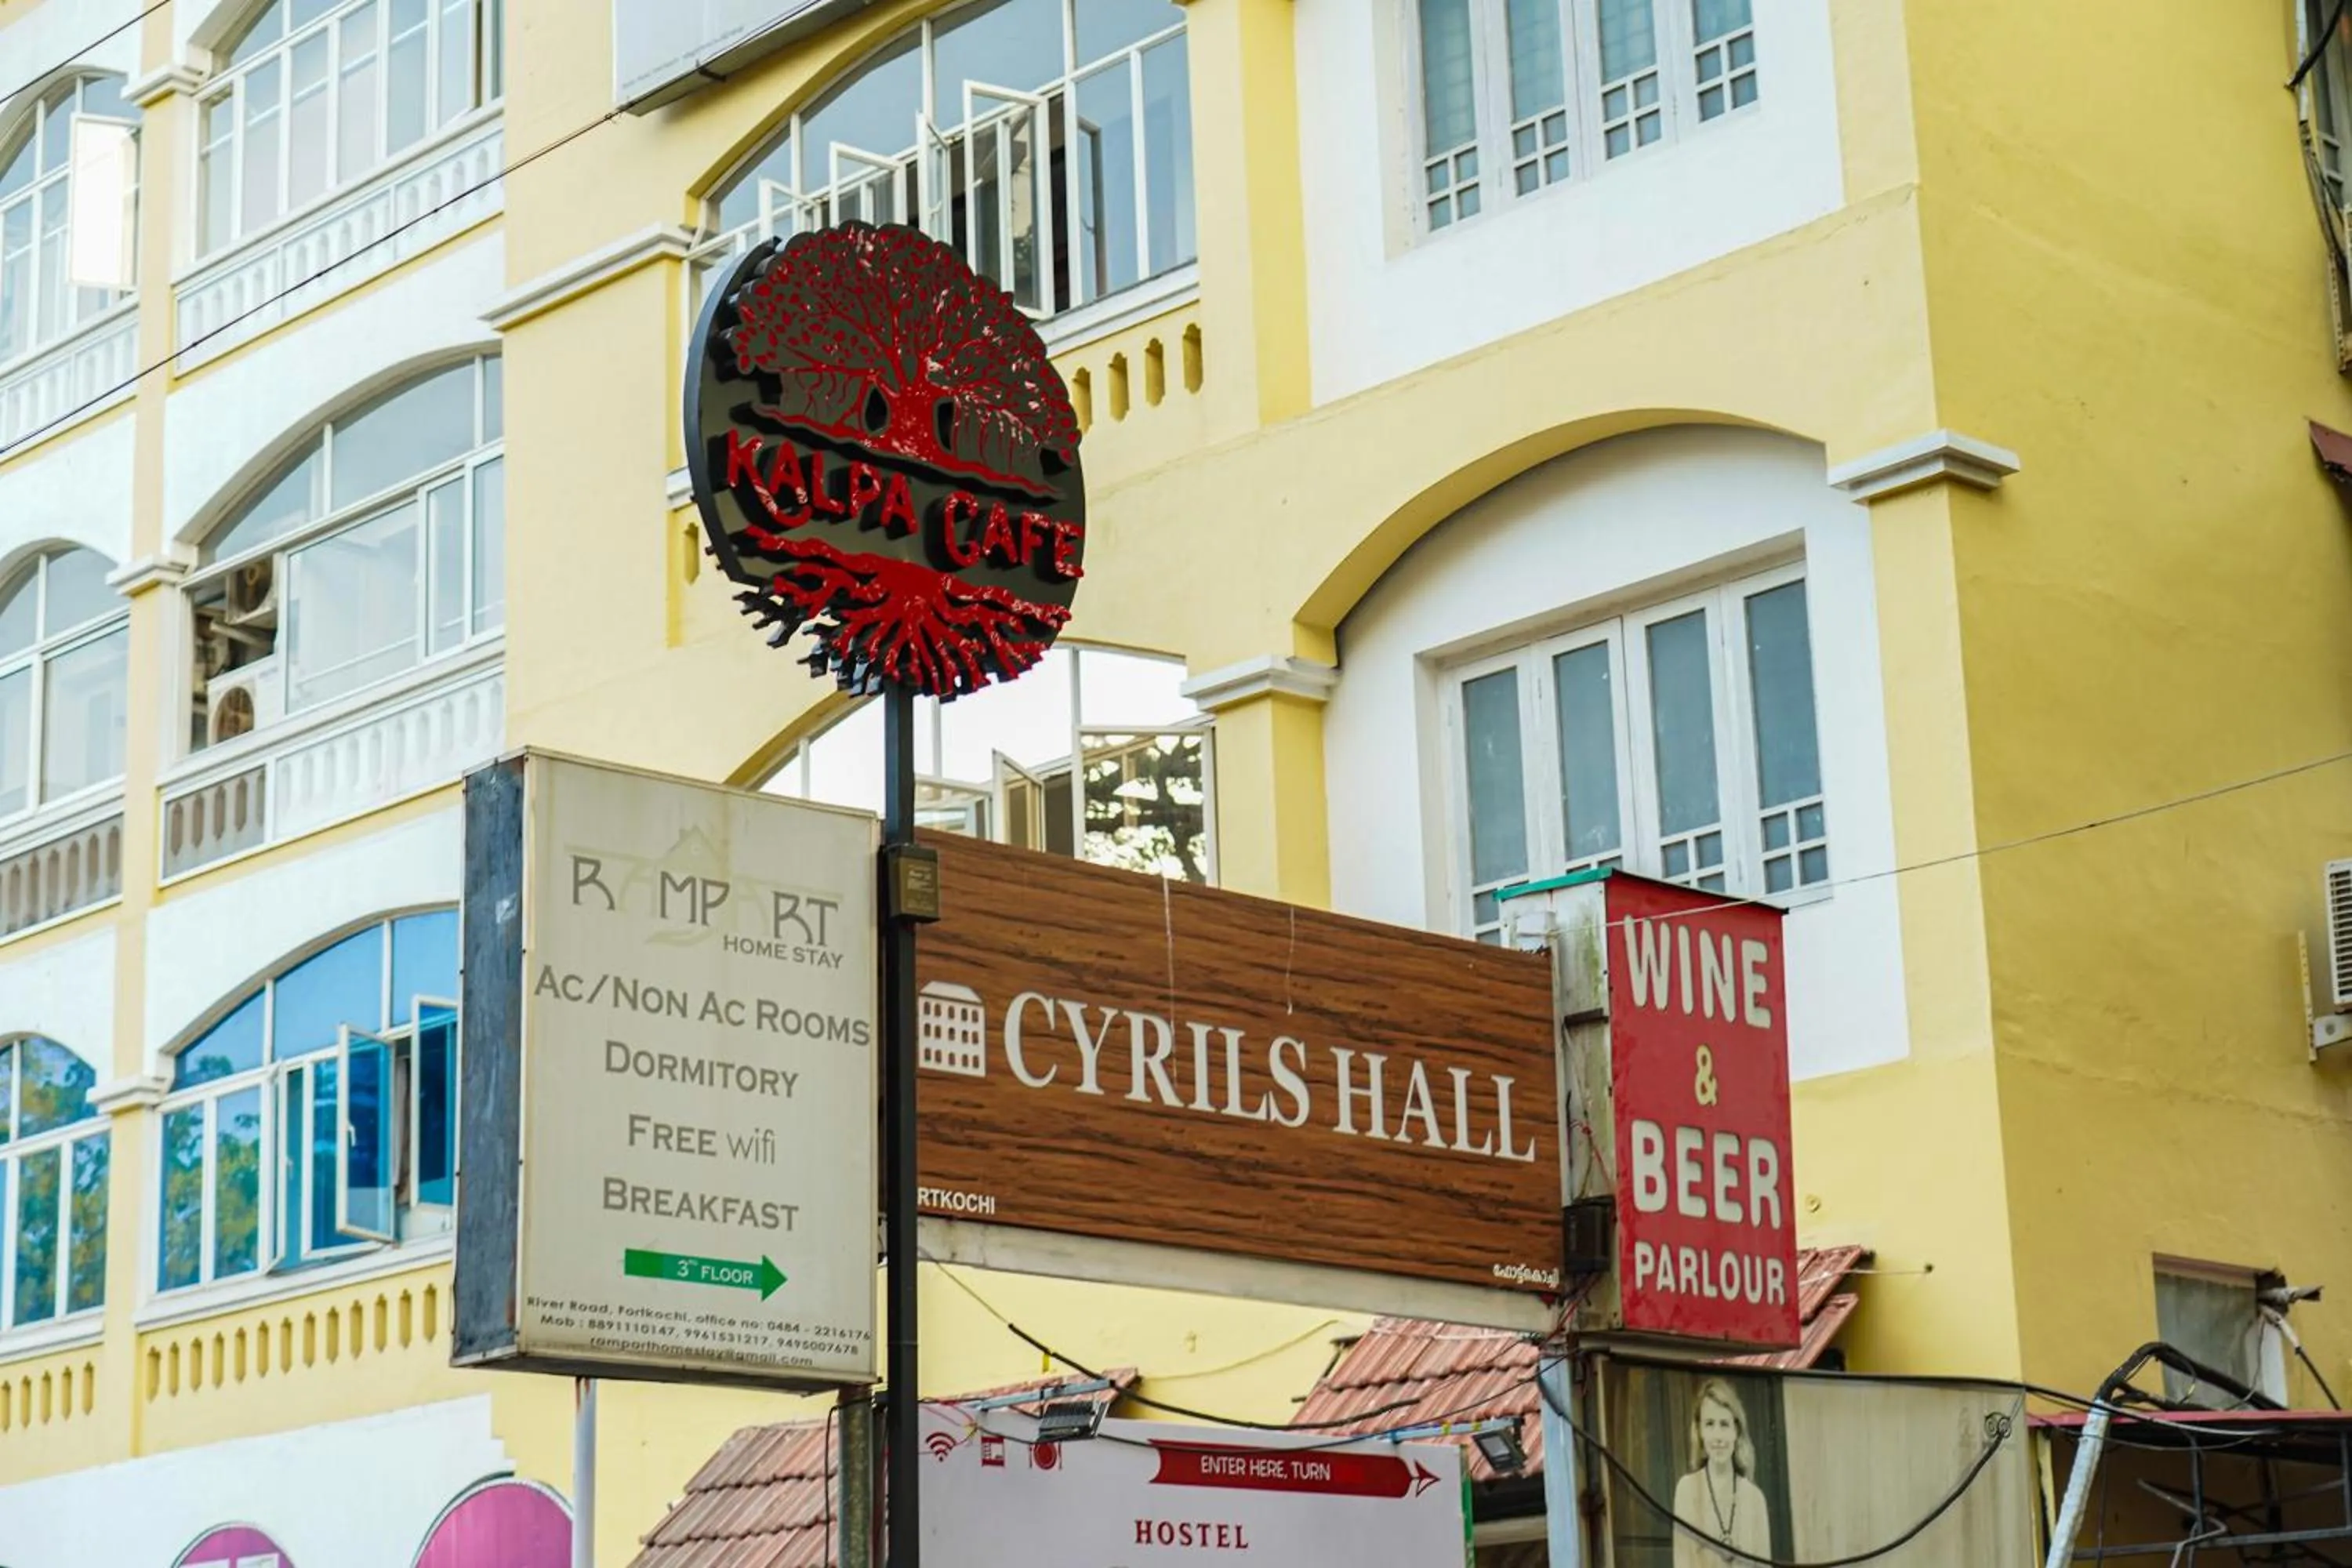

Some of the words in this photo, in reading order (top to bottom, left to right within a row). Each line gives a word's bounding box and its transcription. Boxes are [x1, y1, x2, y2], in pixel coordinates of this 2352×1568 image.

[727, 429, 919, 535] KALPA
[943, 490, 1084, 580] CAFE
[723, 935, 788, 960] HOME
[793, 946, 844, 970] STAY
[1623, 914, 1772, 1029] WINE
[756, 999, 871, 1047] ROOMS
[605, 1040, 799, 1098] DORMITORY
[1003, 991, 1310, 1129] CYRILS
[1329, 1047, 1537, 1163] HALL
[1693, 1044, 1719, 1107] &
[629, 1114, 717, 1157] FREE
[727, 1127, 776, 1165] wifi
[1630, 1120, 1782, 1230] BEER
[603, 1177, 800, 1232] BREAKFAST
[701, 1265, 753, 1285] FLOOR
[1634, 1241, 1786, 1306] PARLOUR
[527, 1297, 564, 1310] River
[569, 1300, 612, 1316] Road,
[695, 1314, 736, 1327] office
[1201, 1455, 1246, 1476] ENTER
[1250, 1460, 1287, 1479] HERE,
[1291, 1461, 1331, 1481] TURN
[1134, 1519, 1250, 1549] HOSTEL
